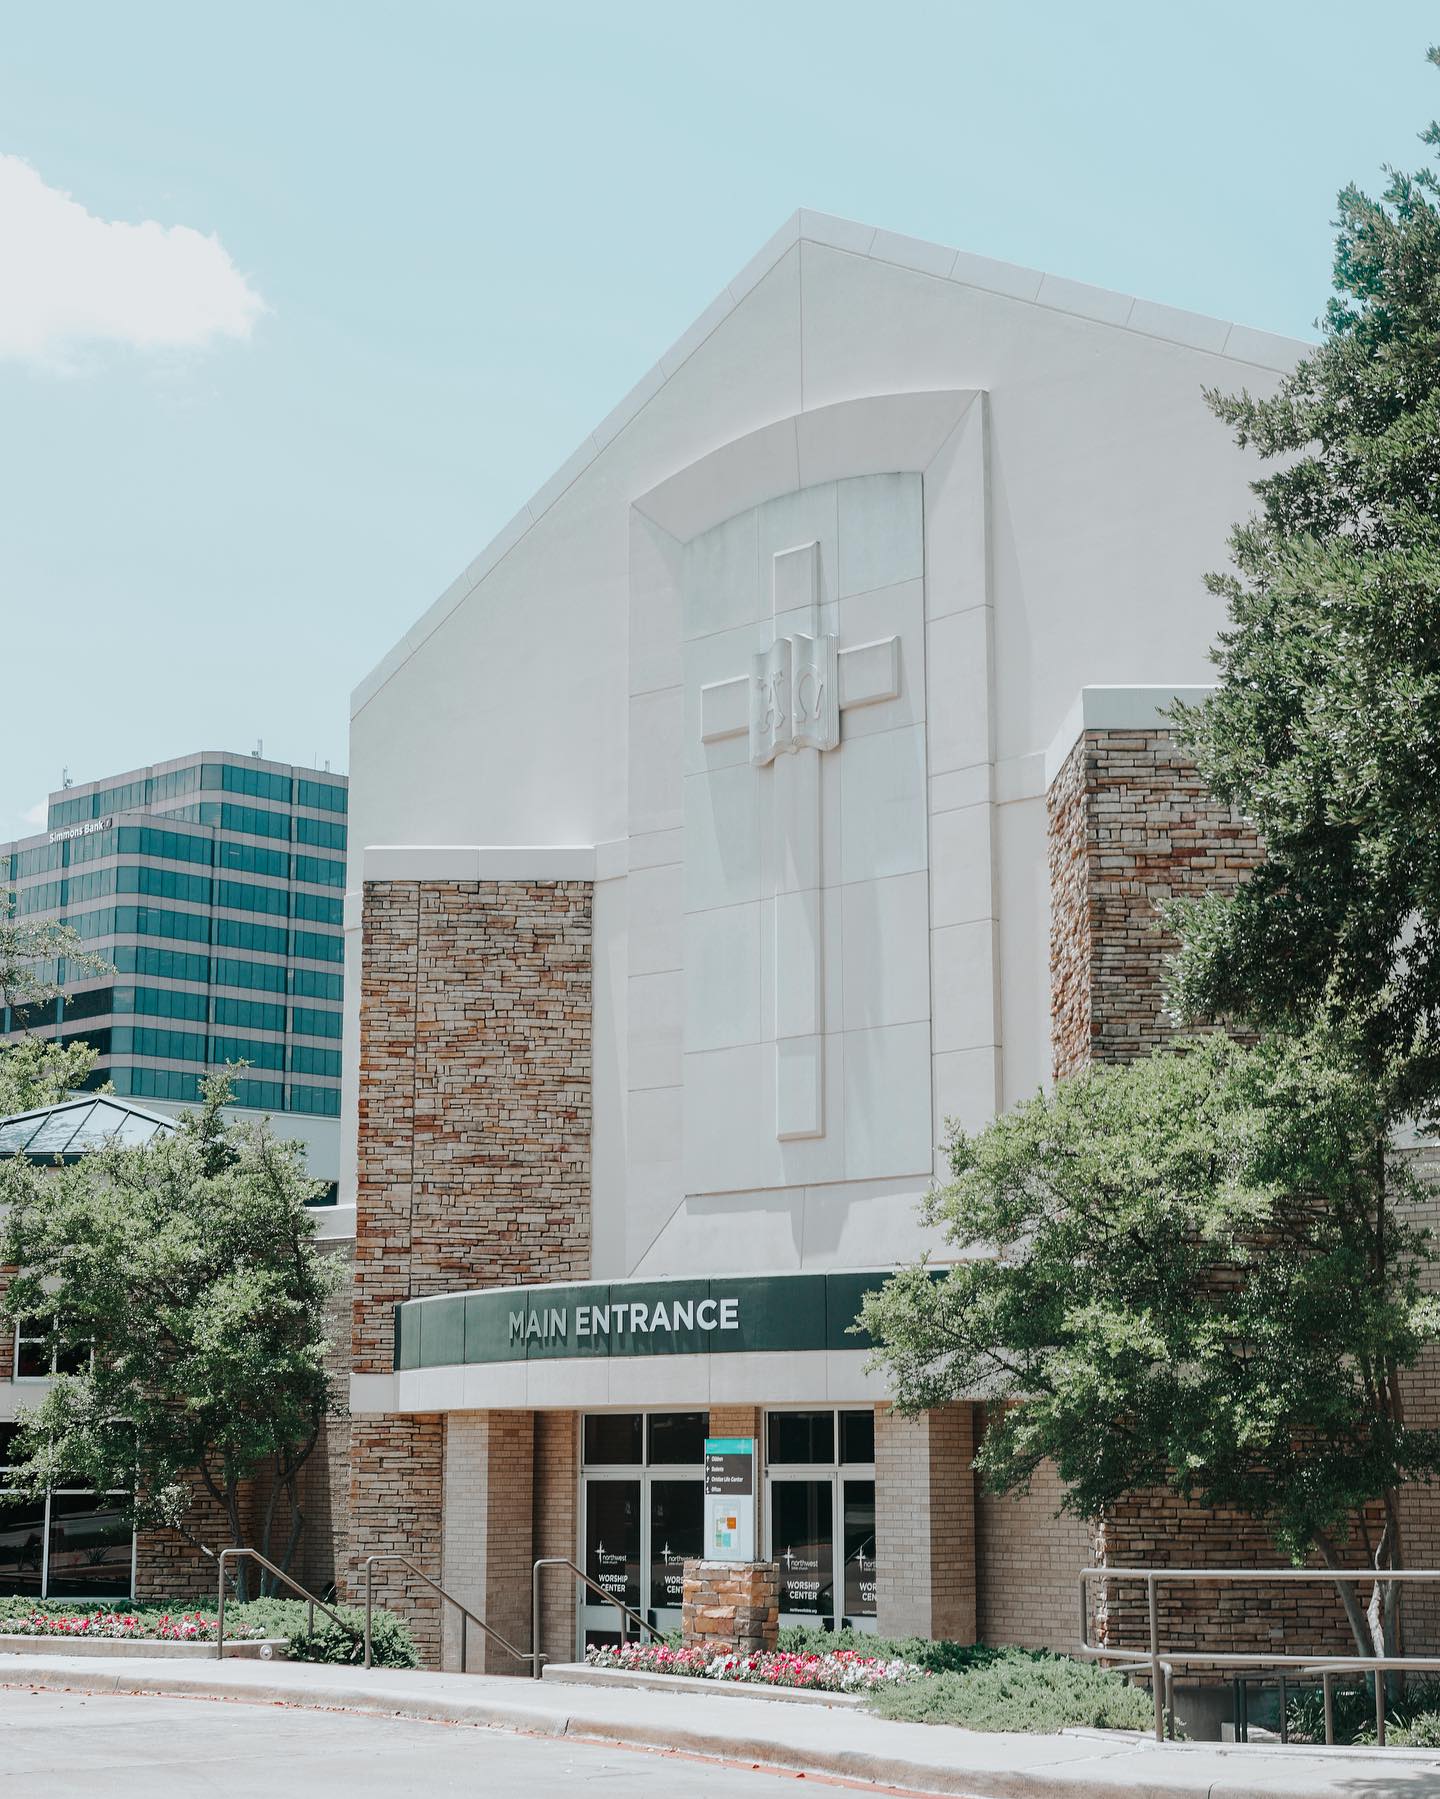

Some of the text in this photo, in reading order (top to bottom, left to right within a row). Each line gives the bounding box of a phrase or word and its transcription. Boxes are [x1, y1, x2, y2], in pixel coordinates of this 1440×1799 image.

[49, 820, 103, 843] Simmons Bank
[509, 1299, 739, 1339] MAIN ENTRANCE
[791, 1560, 818, 1568] northwest
[599, 1574, 628, 1583] WORSHIP
[600, 1584, 626, 1593] CENTER
[787, 1581, 820, 1590] WORSHIP
[789, 1591, 817, 1600] CENTER
